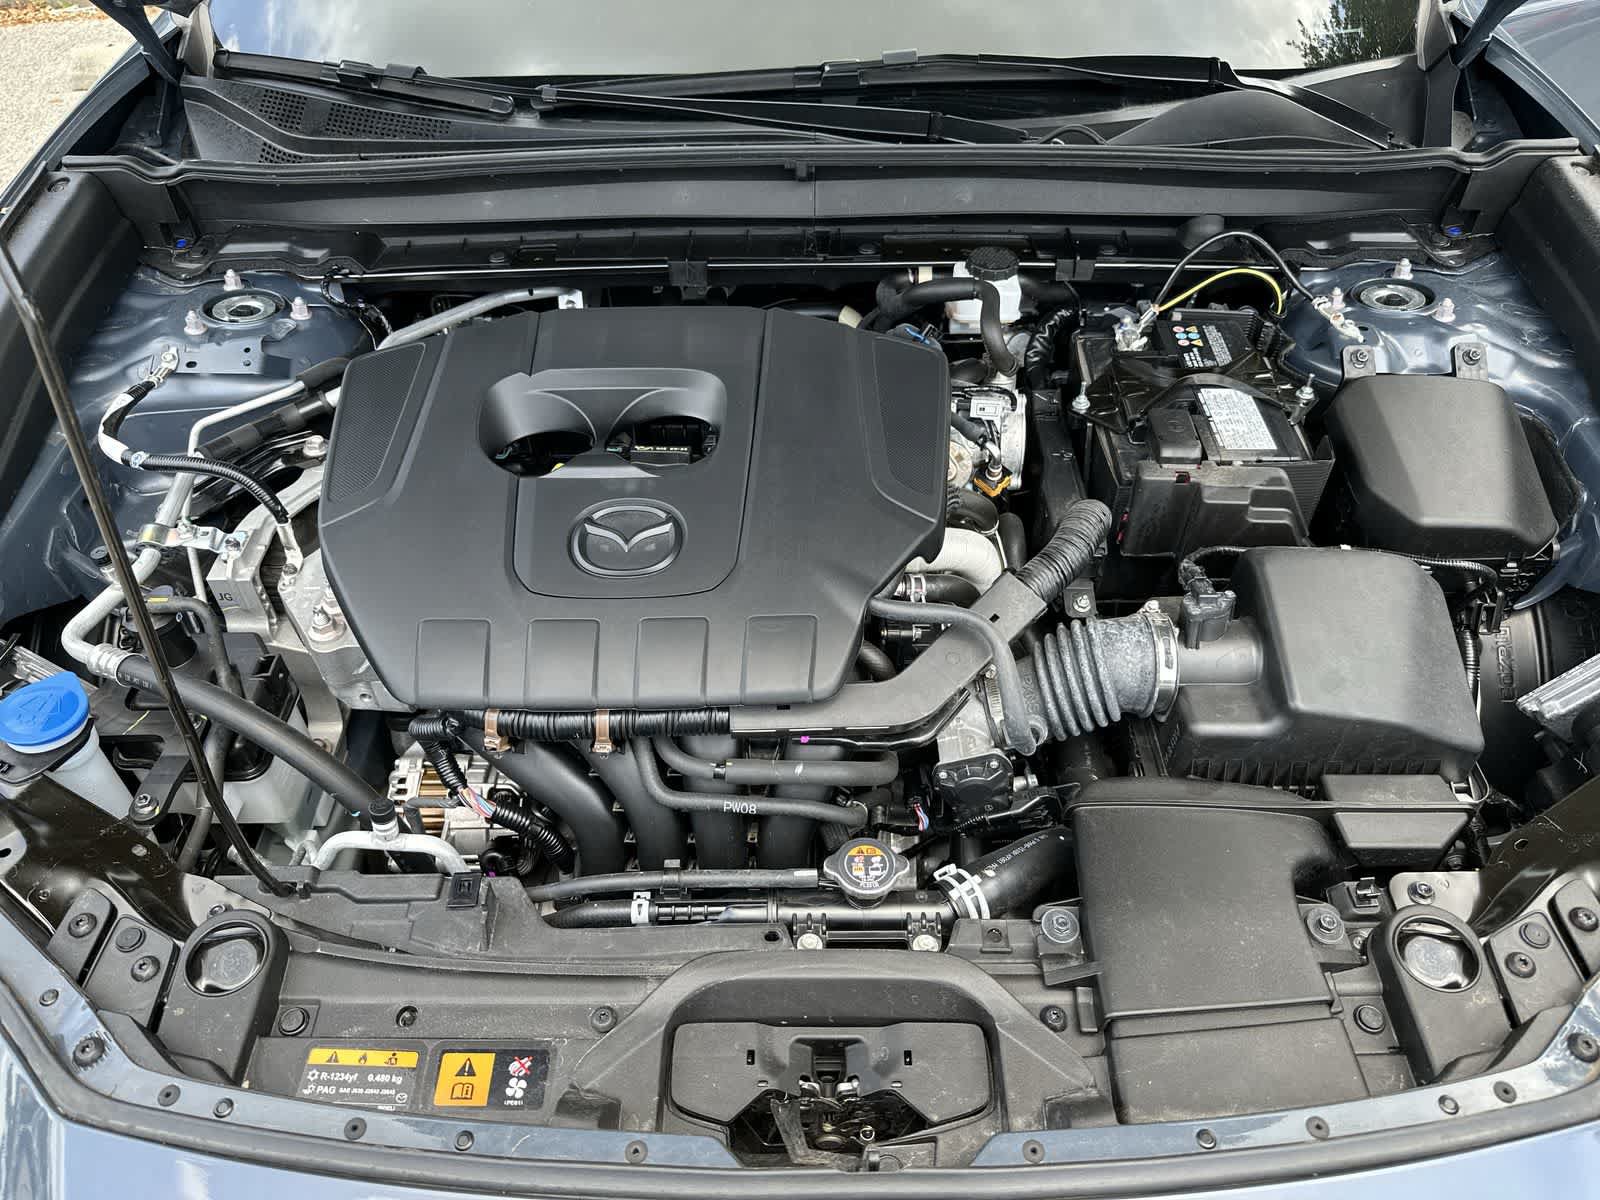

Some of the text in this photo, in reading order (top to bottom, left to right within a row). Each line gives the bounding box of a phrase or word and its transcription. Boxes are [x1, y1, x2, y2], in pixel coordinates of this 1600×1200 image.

[218, 593, 233, 602] JG
[723, 801, 757, 815] PW08
[391, 1074, 403, 1085] kg
[316, 1085, 336, 1095] PAG
